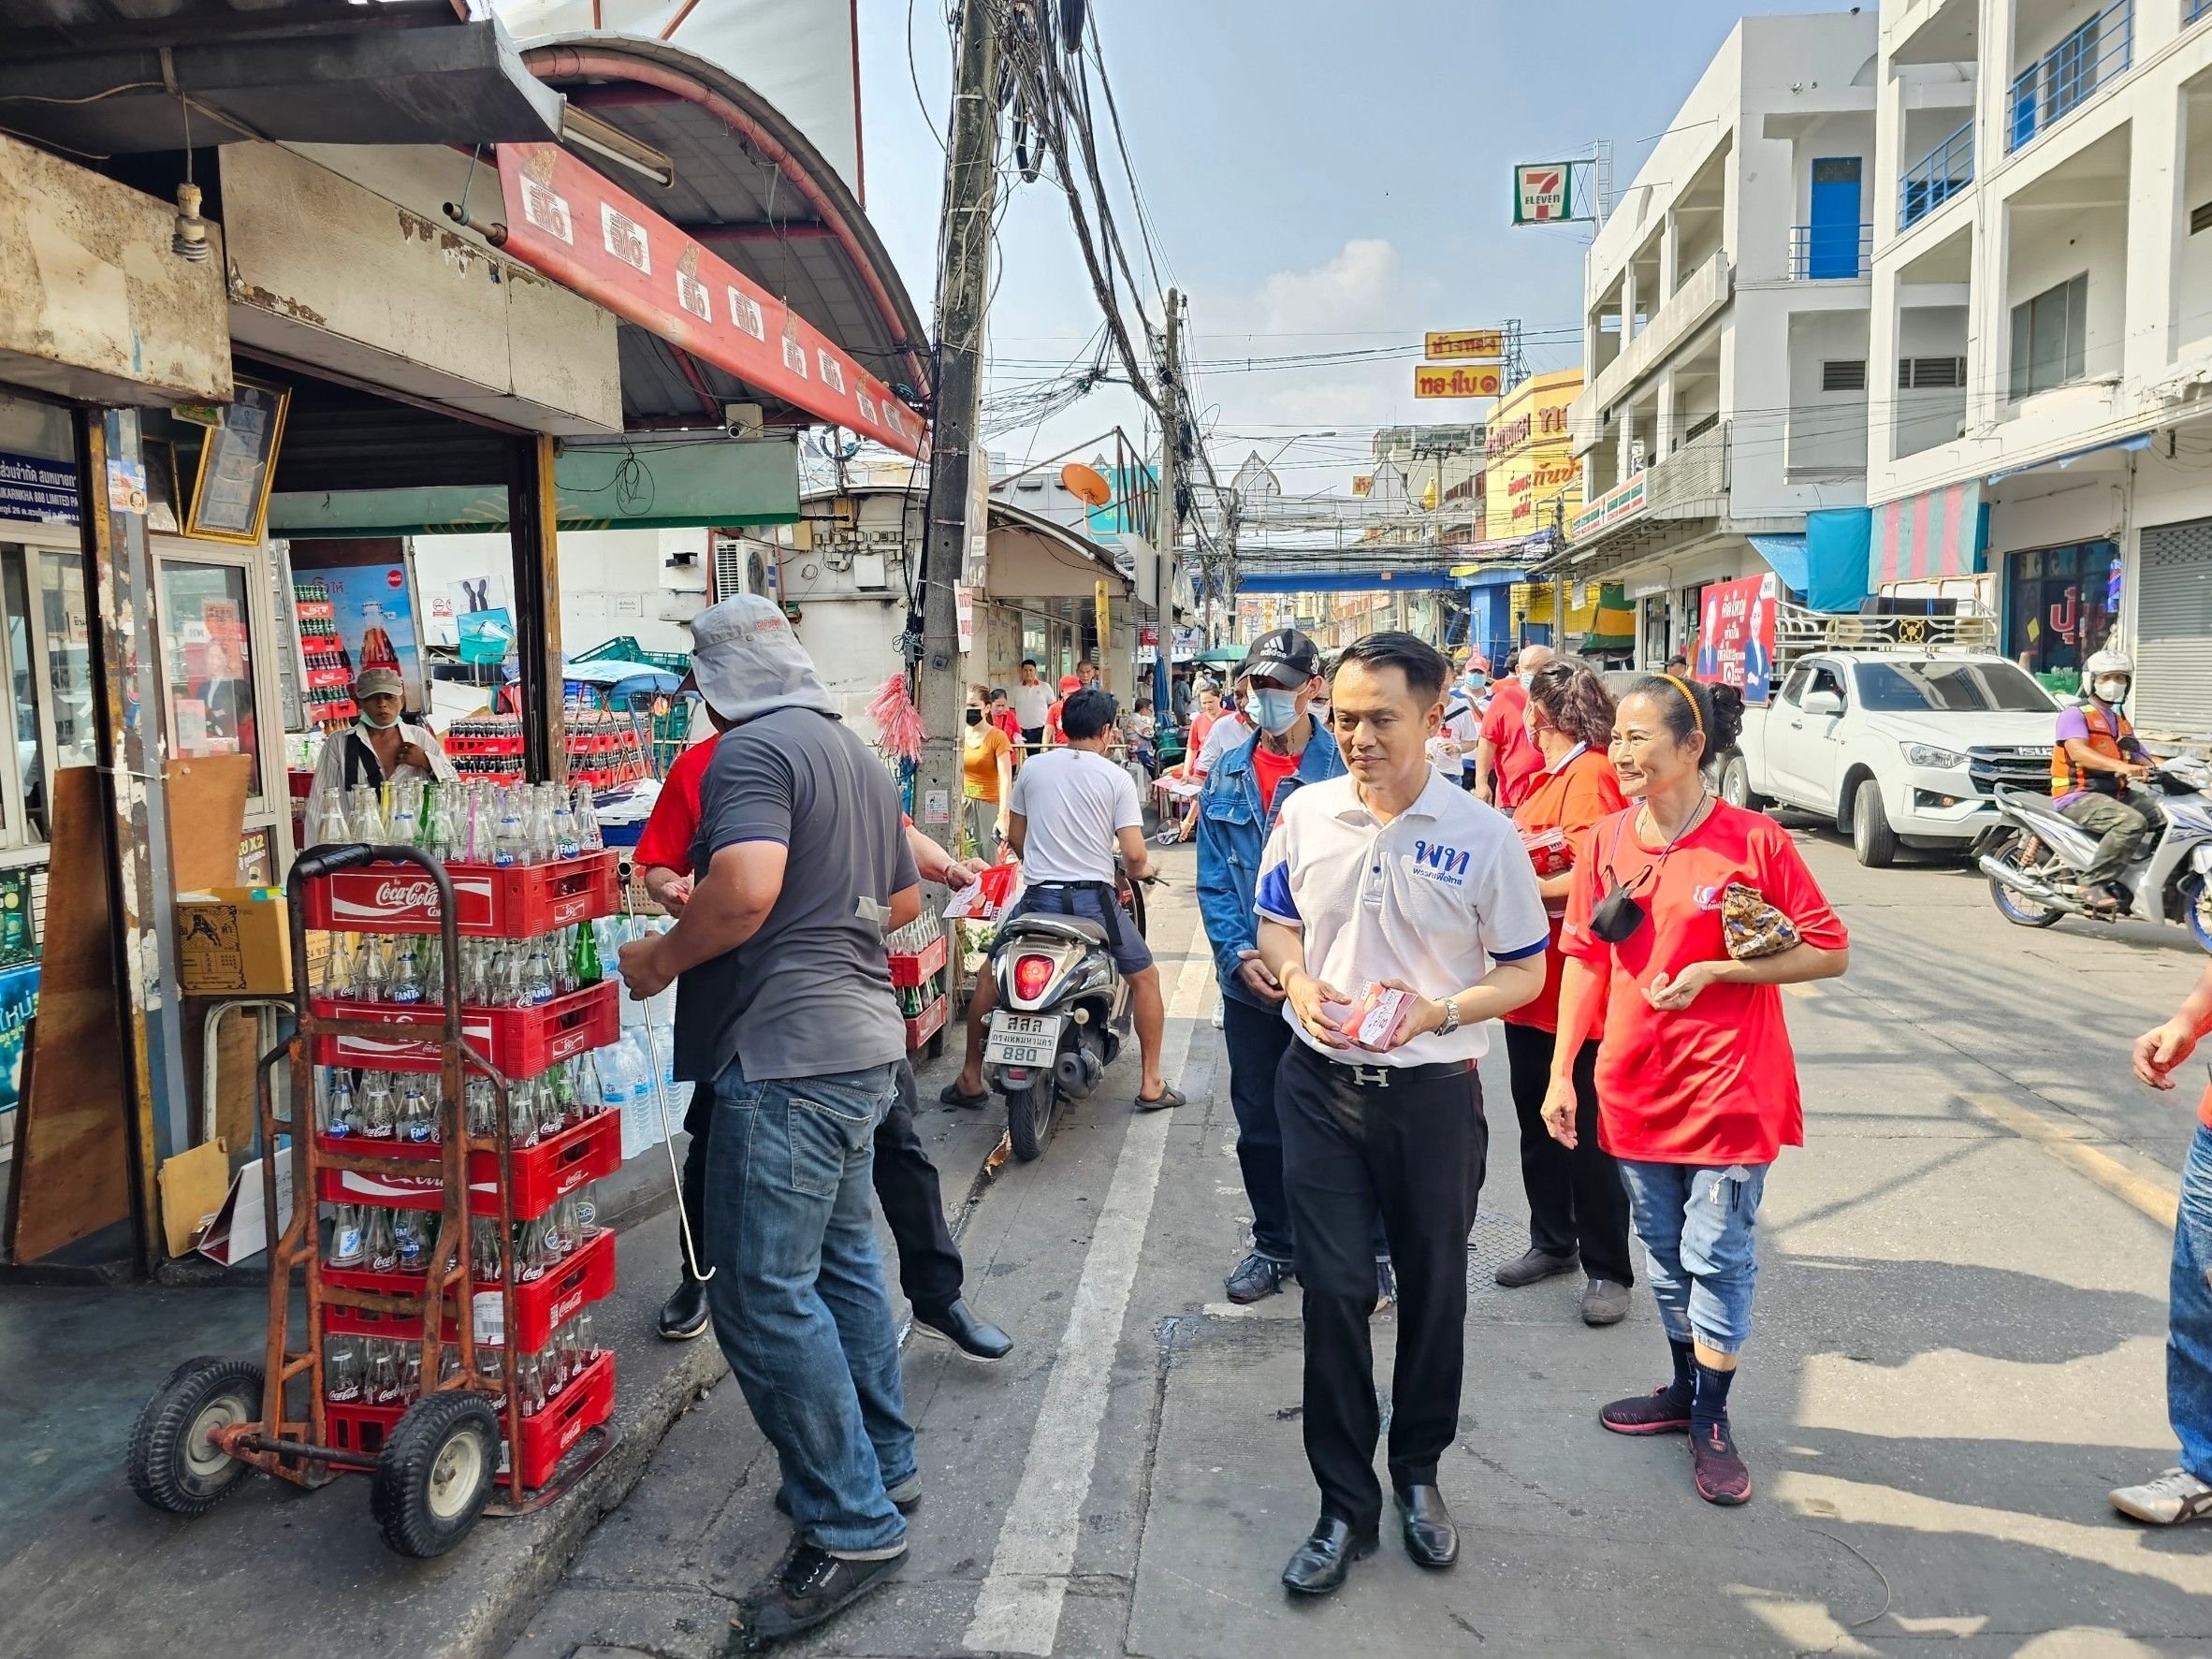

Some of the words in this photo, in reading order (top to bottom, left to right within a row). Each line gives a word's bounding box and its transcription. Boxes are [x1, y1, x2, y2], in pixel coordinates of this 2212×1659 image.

[47, 493, 69, 506] LIMITED
[1260, 648, 1288, 659] adidas
[1415, 840, 1470, 875] พท
[1413, 867, 1463, 885] พรรคเพื่อไทย
[394, 989, 420, 1001] FANTA
[532, 986, 553, 998] ANTA
[1003, 1047, 1038, 1062] 880
[328, 1385, 359, 1401] Coca-Cola
